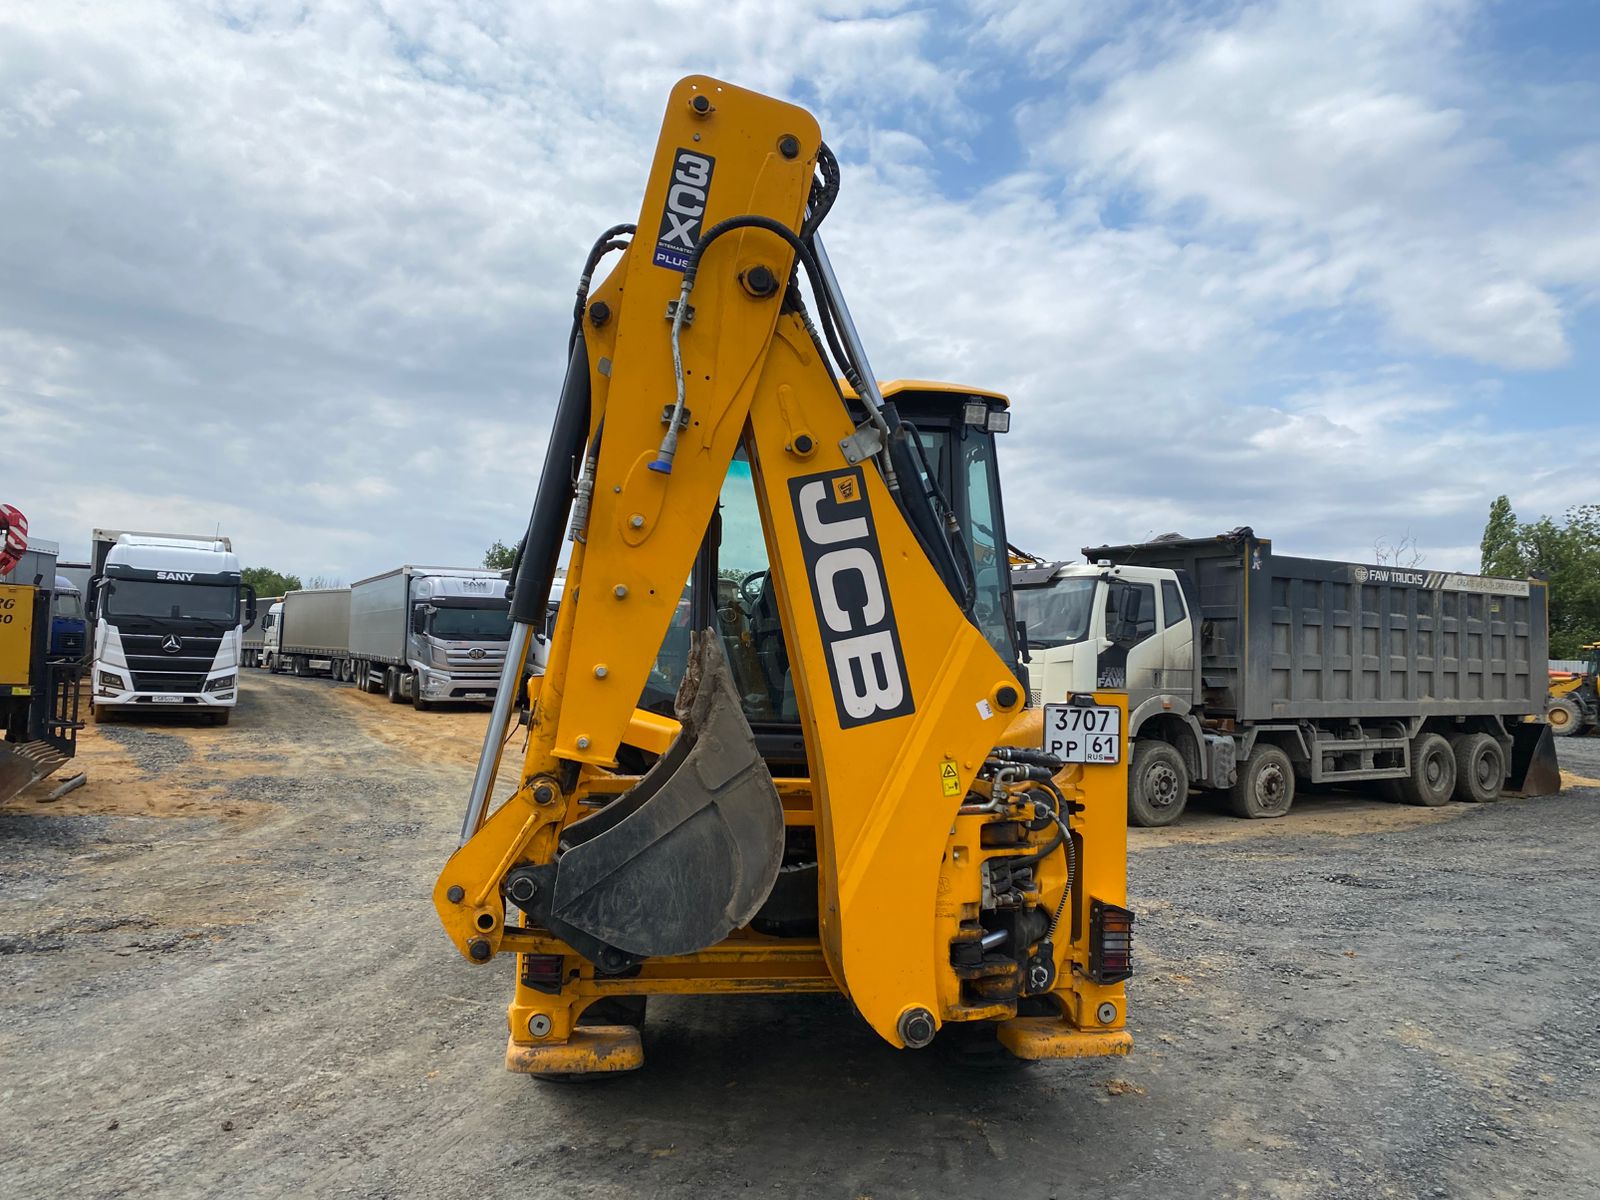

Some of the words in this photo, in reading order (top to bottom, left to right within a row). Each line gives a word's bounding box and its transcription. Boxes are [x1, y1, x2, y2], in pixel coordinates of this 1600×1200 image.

[660, 153, 710, 248] 3CX
[657, 253, 688, 267] PLUS
[157, 572, 195, 581] SANY
[1369, 569, 1390, 582] FAW
[1390, 571, 1424, 585] TRUCKS
[799, 480, 904, 719] JCB
[1097, 677, 1125, 688] FAW
[1055, 708, 1110, 732] 3707
[1051, 740, 1078, 758] PP
[1092, 736, 1113, 754] 61
[1087, 753, 1104, 761] RUS
